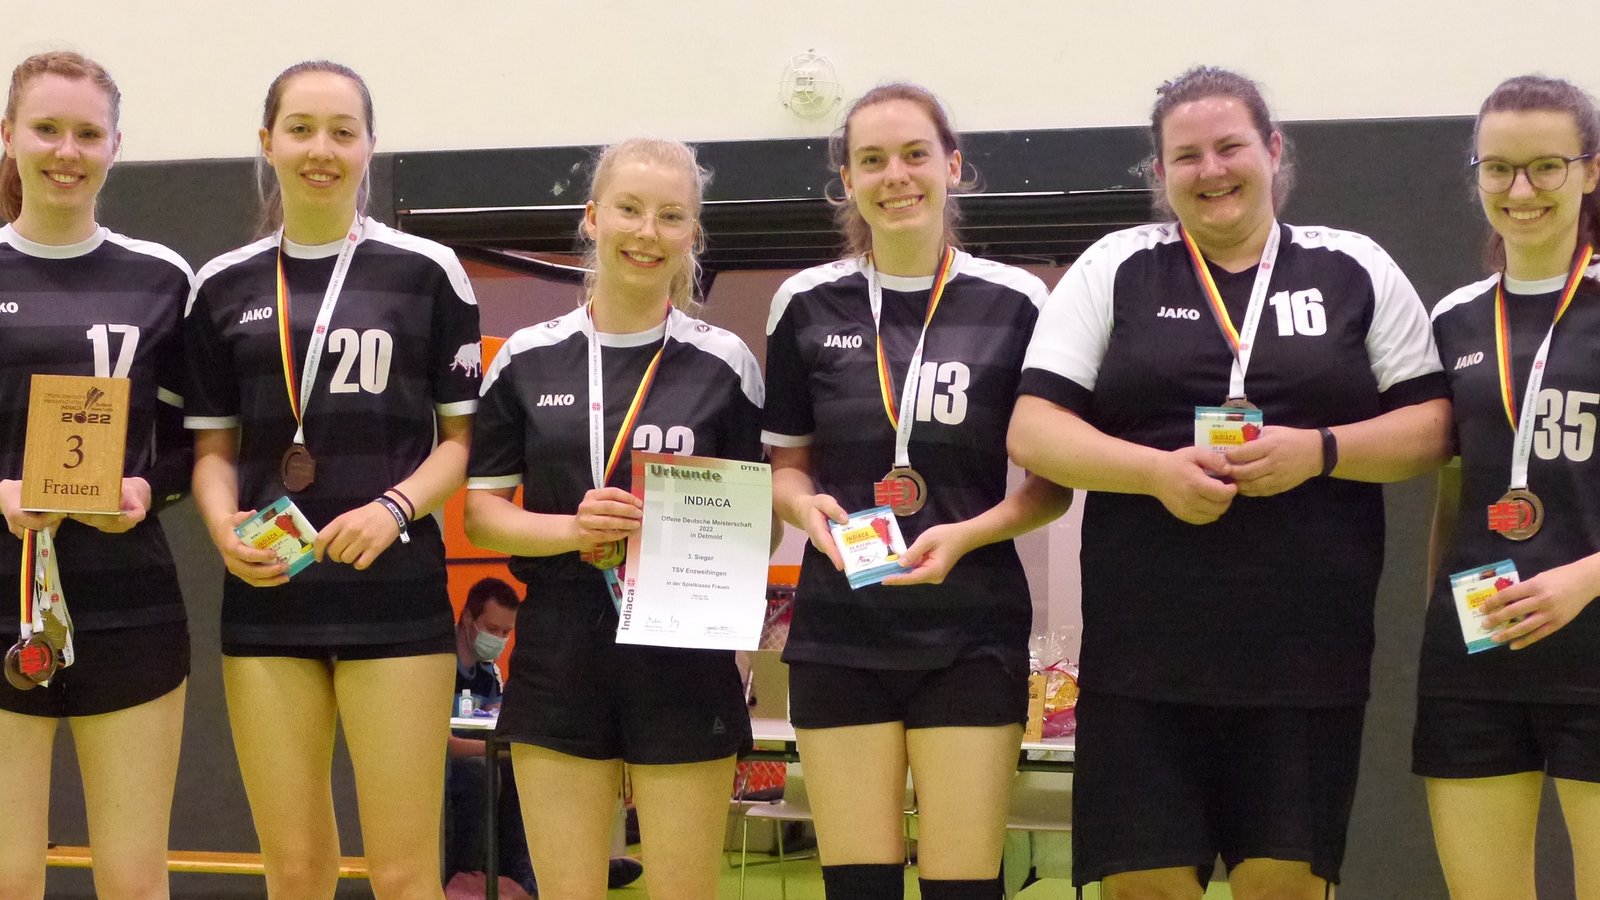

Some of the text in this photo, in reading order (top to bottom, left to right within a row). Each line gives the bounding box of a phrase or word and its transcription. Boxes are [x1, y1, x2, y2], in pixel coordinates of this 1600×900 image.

[239, 306, 273, 324] JAKO
[1156, 306, 1200, 320] JAKO
[1269, 287, 1328, 337] 16
[823, 334, 863, 349] JAKO
[86, 323, 140, 378] 17
[328, 328, 393, 394] 20
[1454, 351, 1484, 371] JAKO
[536, 393, 575, 407] JAKO
[916, 361, 970, 425] 13
[61, 412, 111, 424] 2022
[1534, 388, 1600, 462] 35
[63, 435, 84, 469] 3
[650, 464, 722, 483] Urkunde
[740, 464, 760, 472] DTB
[43, 479, 100, 496] Frauen
[684, 495, 731, 508] INDIACA
[661, 515, 752, 528] Offene Deutsche Meisterschaft
[697, 532, 723, 540] Detmold
[685, 567, 727, 577] Enzweihingen
[621, 588, 635, 631] Indiaca
